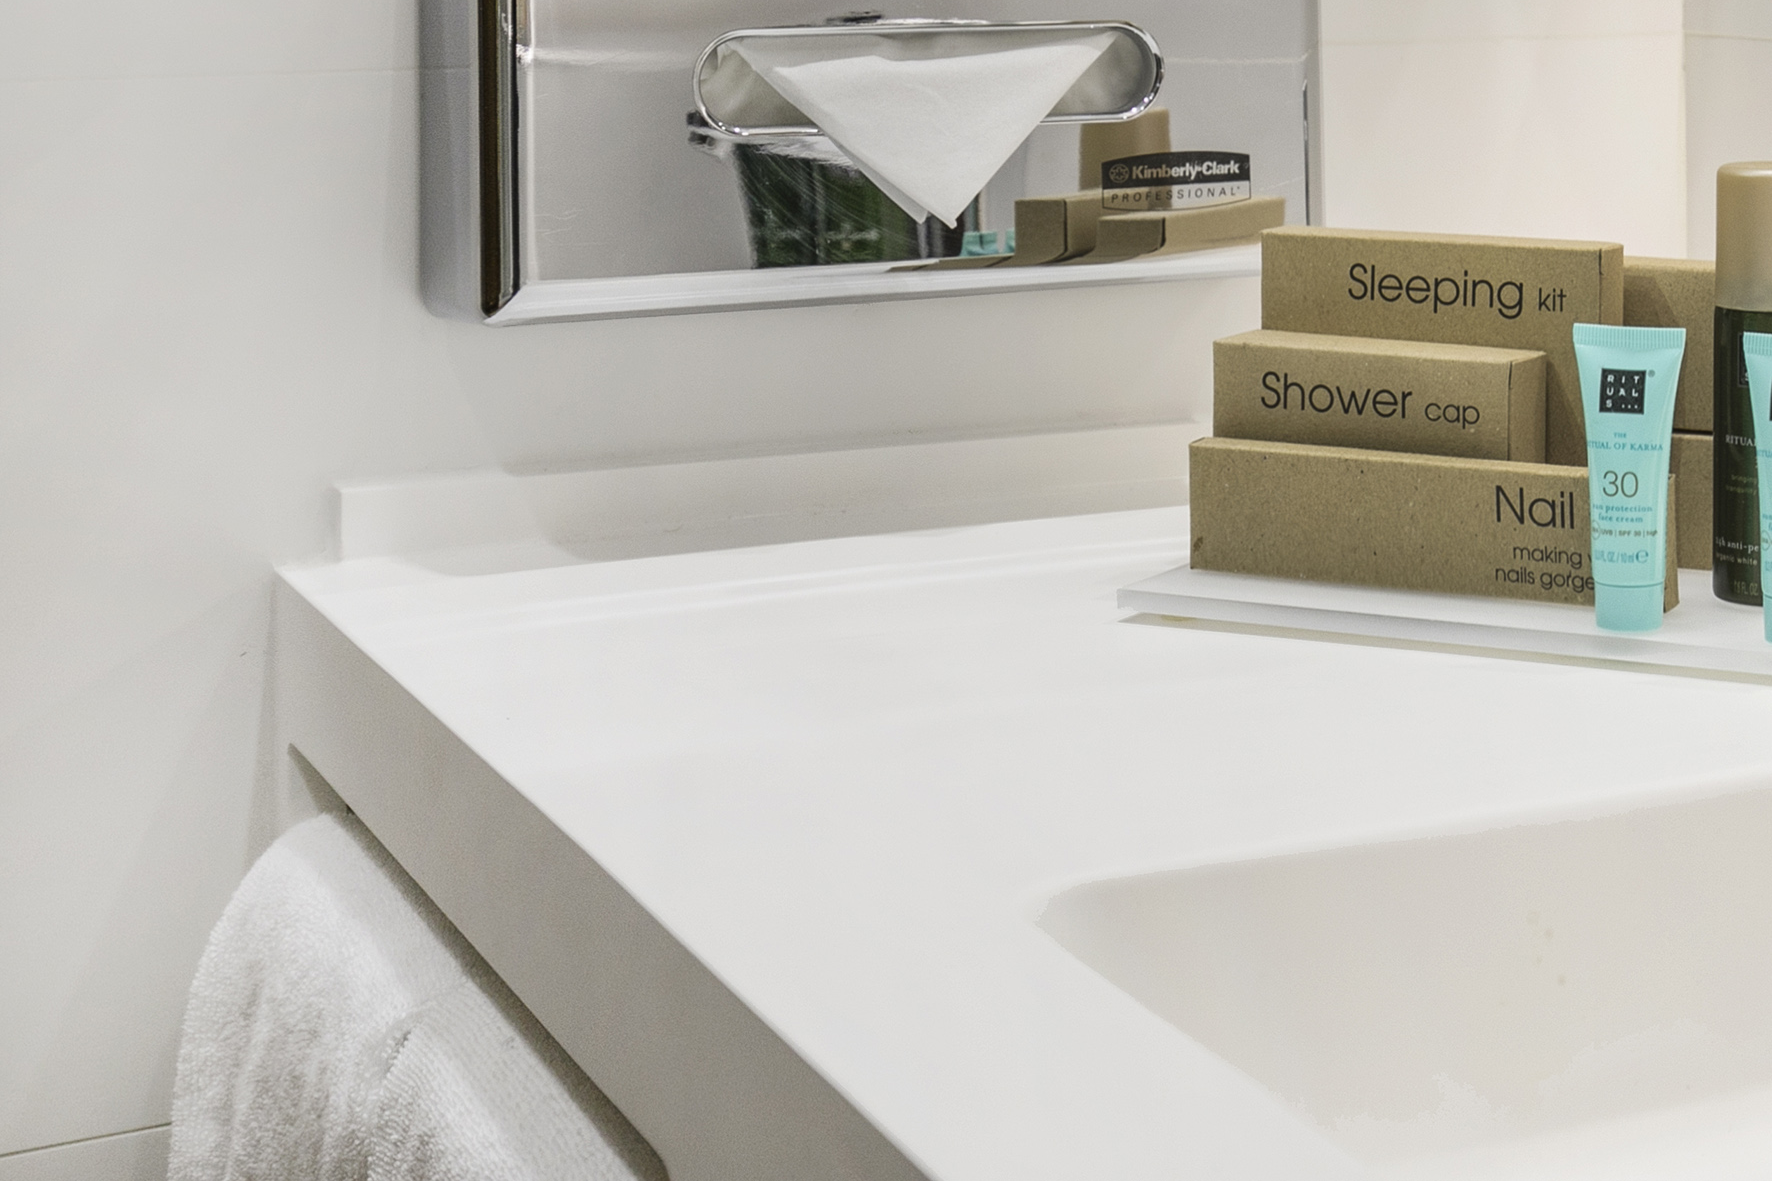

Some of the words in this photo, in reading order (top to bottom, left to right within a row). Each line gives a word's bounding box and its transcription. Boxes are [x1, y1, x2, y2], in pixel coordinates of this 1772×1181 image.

[1111, 186, 1236, 204] PROFESSIONAL
[1348, 263, 1524, 319] Sleeping
[1538, 287, 1567, 312] kit
[1261, 371, 1413, 419] Shower
[1424, 402, 1480, 429] cap
[1613, 442, 1627, 450] OF
[1630, 443, 1663, 451] KARMA
[1603, 470, 1639, 498] 30
[1496, 485, 1574, 529] Nail
[1598, 513, 1613, 522] face
[1605, 504, 1653, 513] protection
[1513, 546, 1582, 570] making
[1495, 566, 1535, 585] nails
